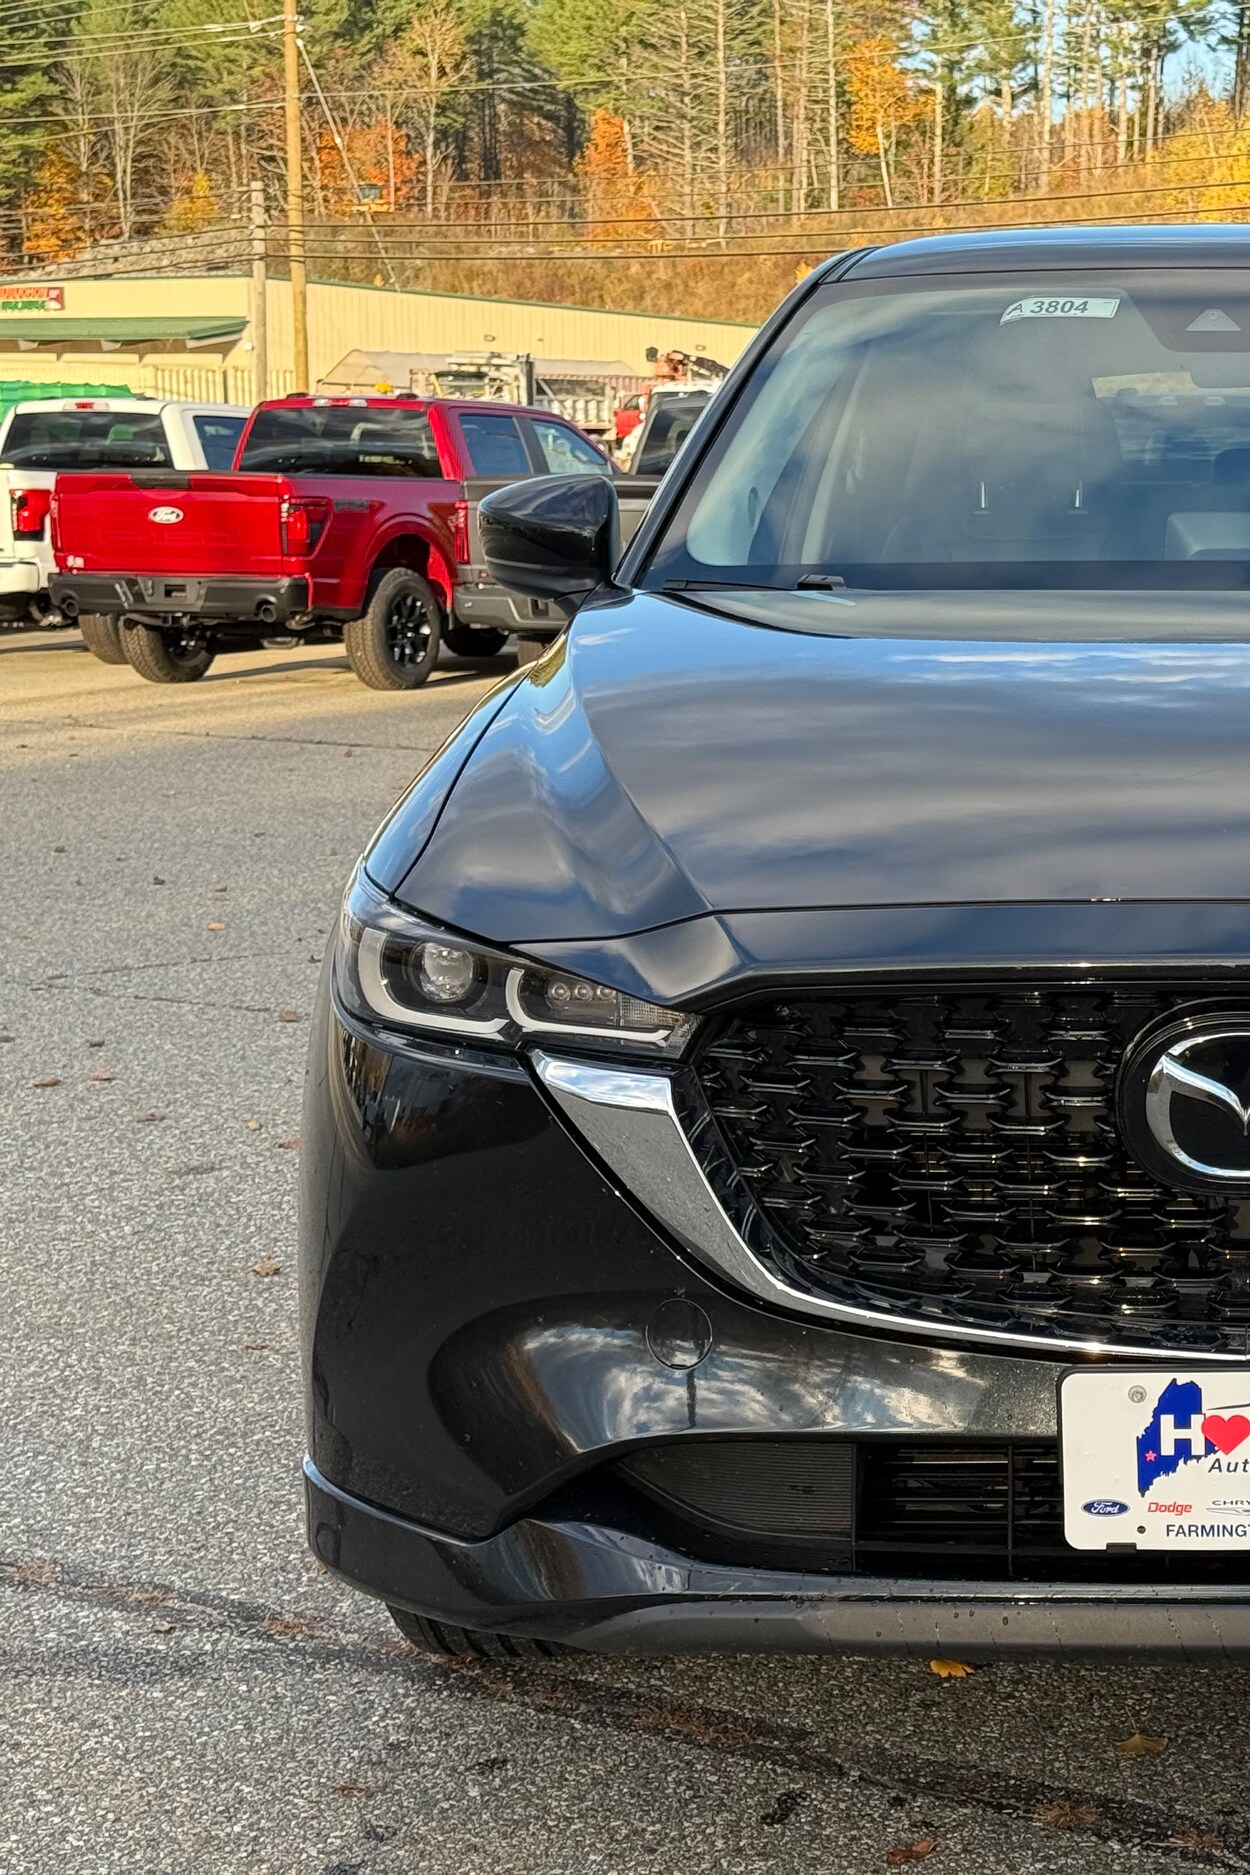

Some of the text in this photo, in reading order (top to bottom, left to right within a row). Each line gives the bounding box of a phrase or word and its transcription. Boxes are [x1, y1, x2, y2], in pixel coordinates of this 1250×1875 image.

[1029, 300, 1089, 314] 3804
[1090, 1501, 1121, 1514] Ford
[1147, 1501, 1193, 1516] Dodge
